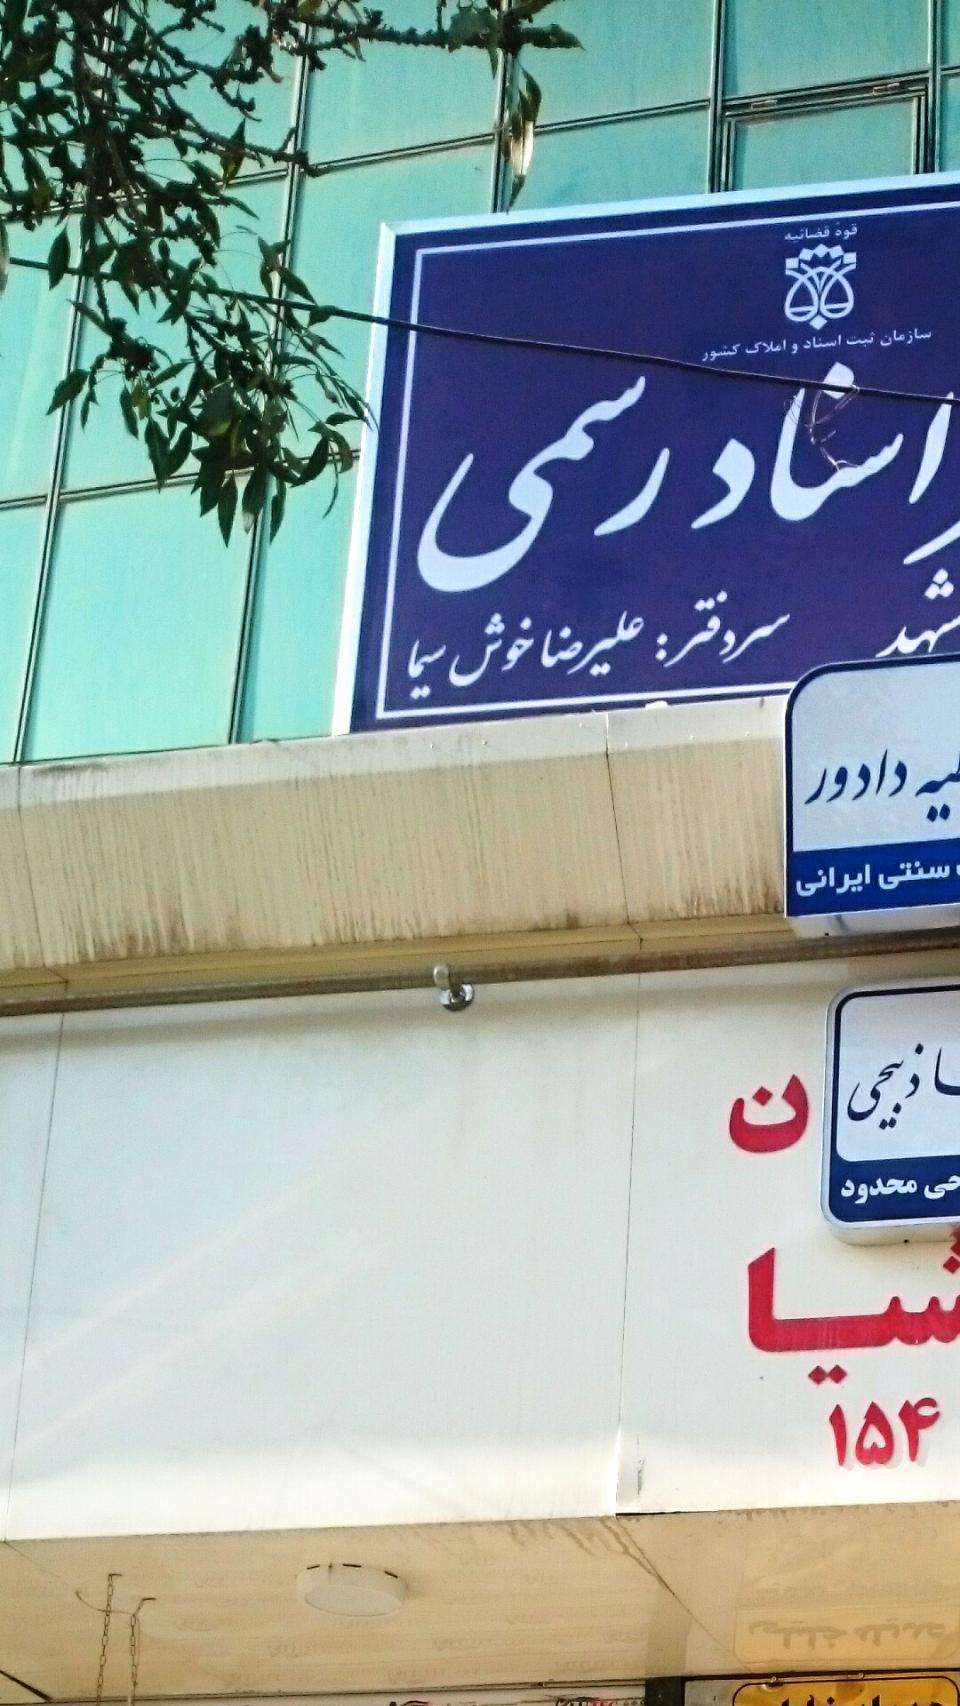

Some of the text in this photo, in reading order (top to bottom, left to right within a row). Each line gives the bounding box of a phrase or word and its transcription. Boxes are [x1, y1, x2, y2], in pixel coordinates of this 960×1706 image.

[702, 329, 932, 362] سازمان ثبت اسناد و املاک کشور
[691, 362, 955, 530] اسناد
[416, 376, 670, 593] رسمی
[407, 639, 446, 699] سیما
[448, 611, 534, 687] خوش
[541, 609, 645, 675] علیرضا
[804, 749, 908, 805] دادور
[796, 864, 871, 898] ایرانی
[878, 860, 950, 891] سنتی
[847, 1043, 925, 1131] ذبیحی
[841, 1175, 918, 1204] محدود
[829, 1397, 941, 1467] ۱۵۴
